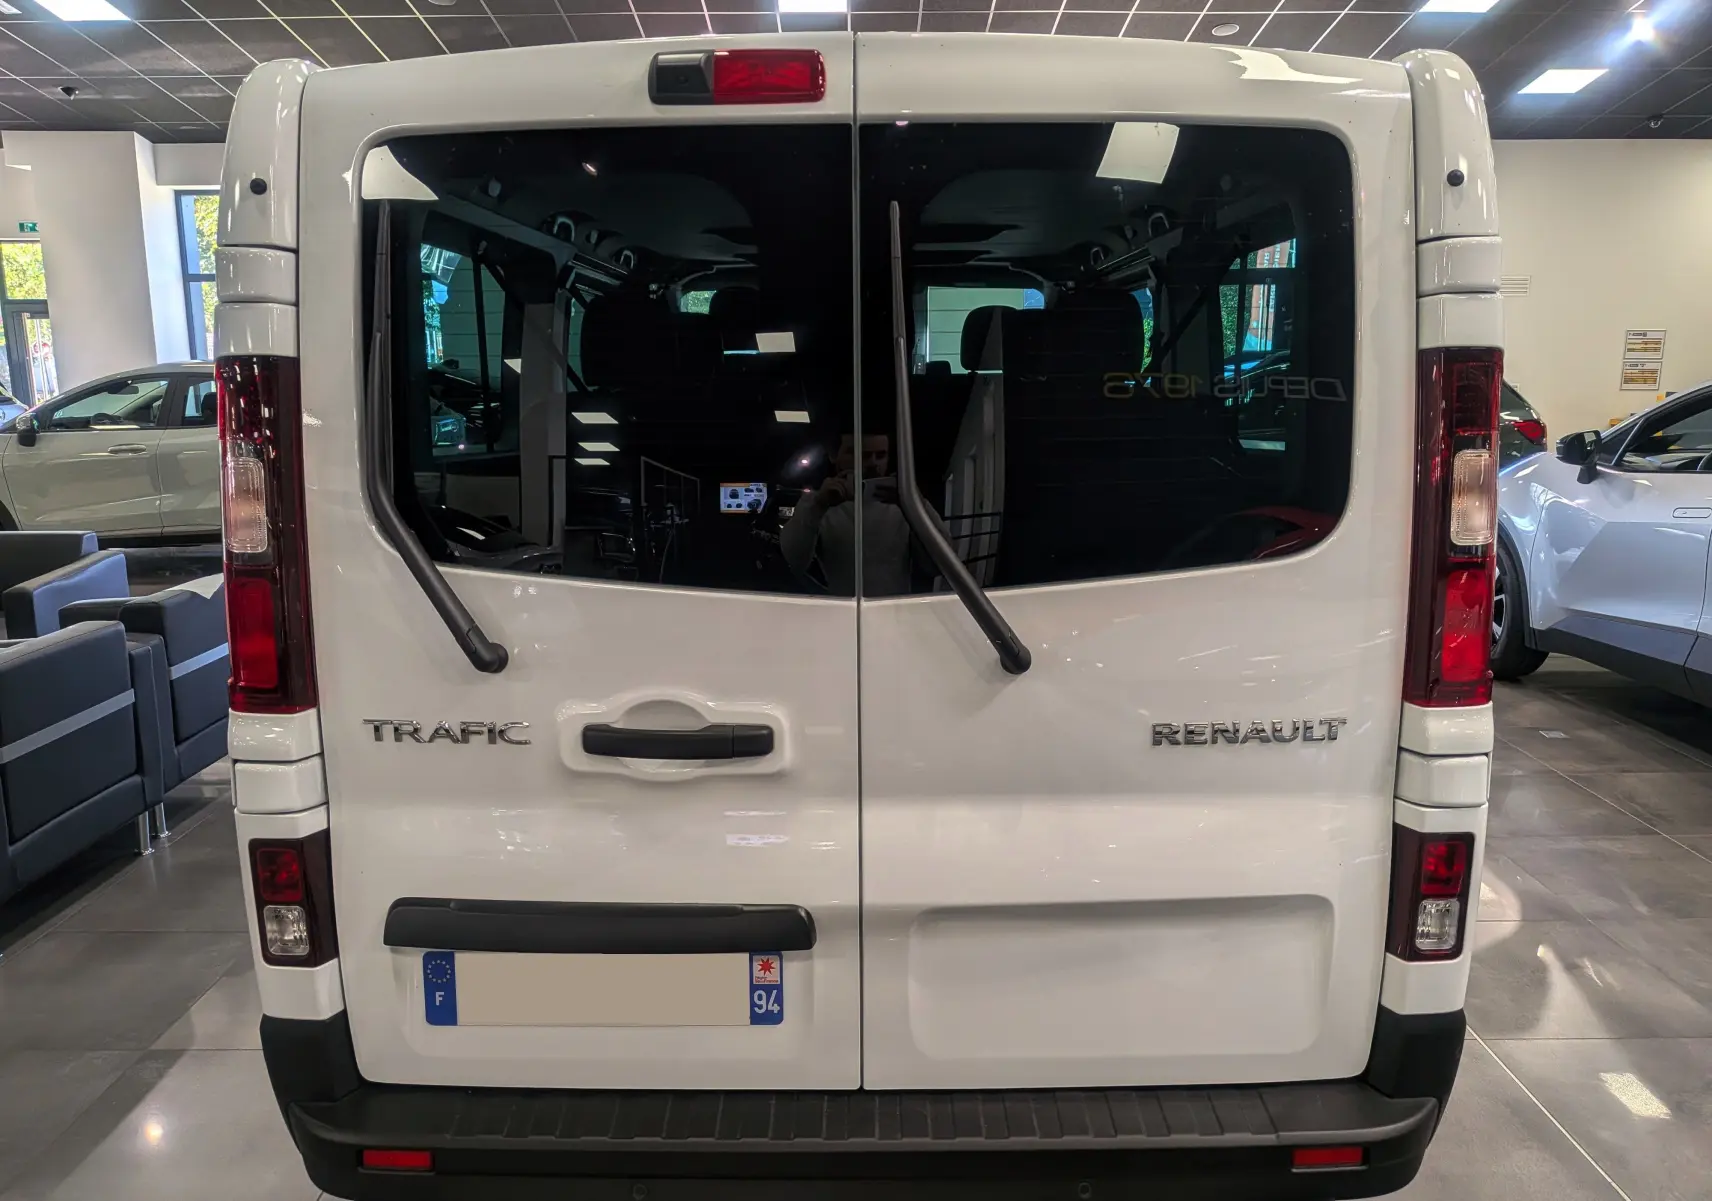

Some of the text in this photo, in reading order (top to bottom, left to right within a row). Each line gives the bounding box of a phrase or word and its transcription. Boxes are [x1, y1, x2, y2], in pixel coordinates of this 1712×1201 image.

[362, 718, 532, 746] TRAFIC
[1151, 717, 1348, 746] RENAULT
[435, 991, 445, 1006] F
[753, 989, 781, 1014] 94
